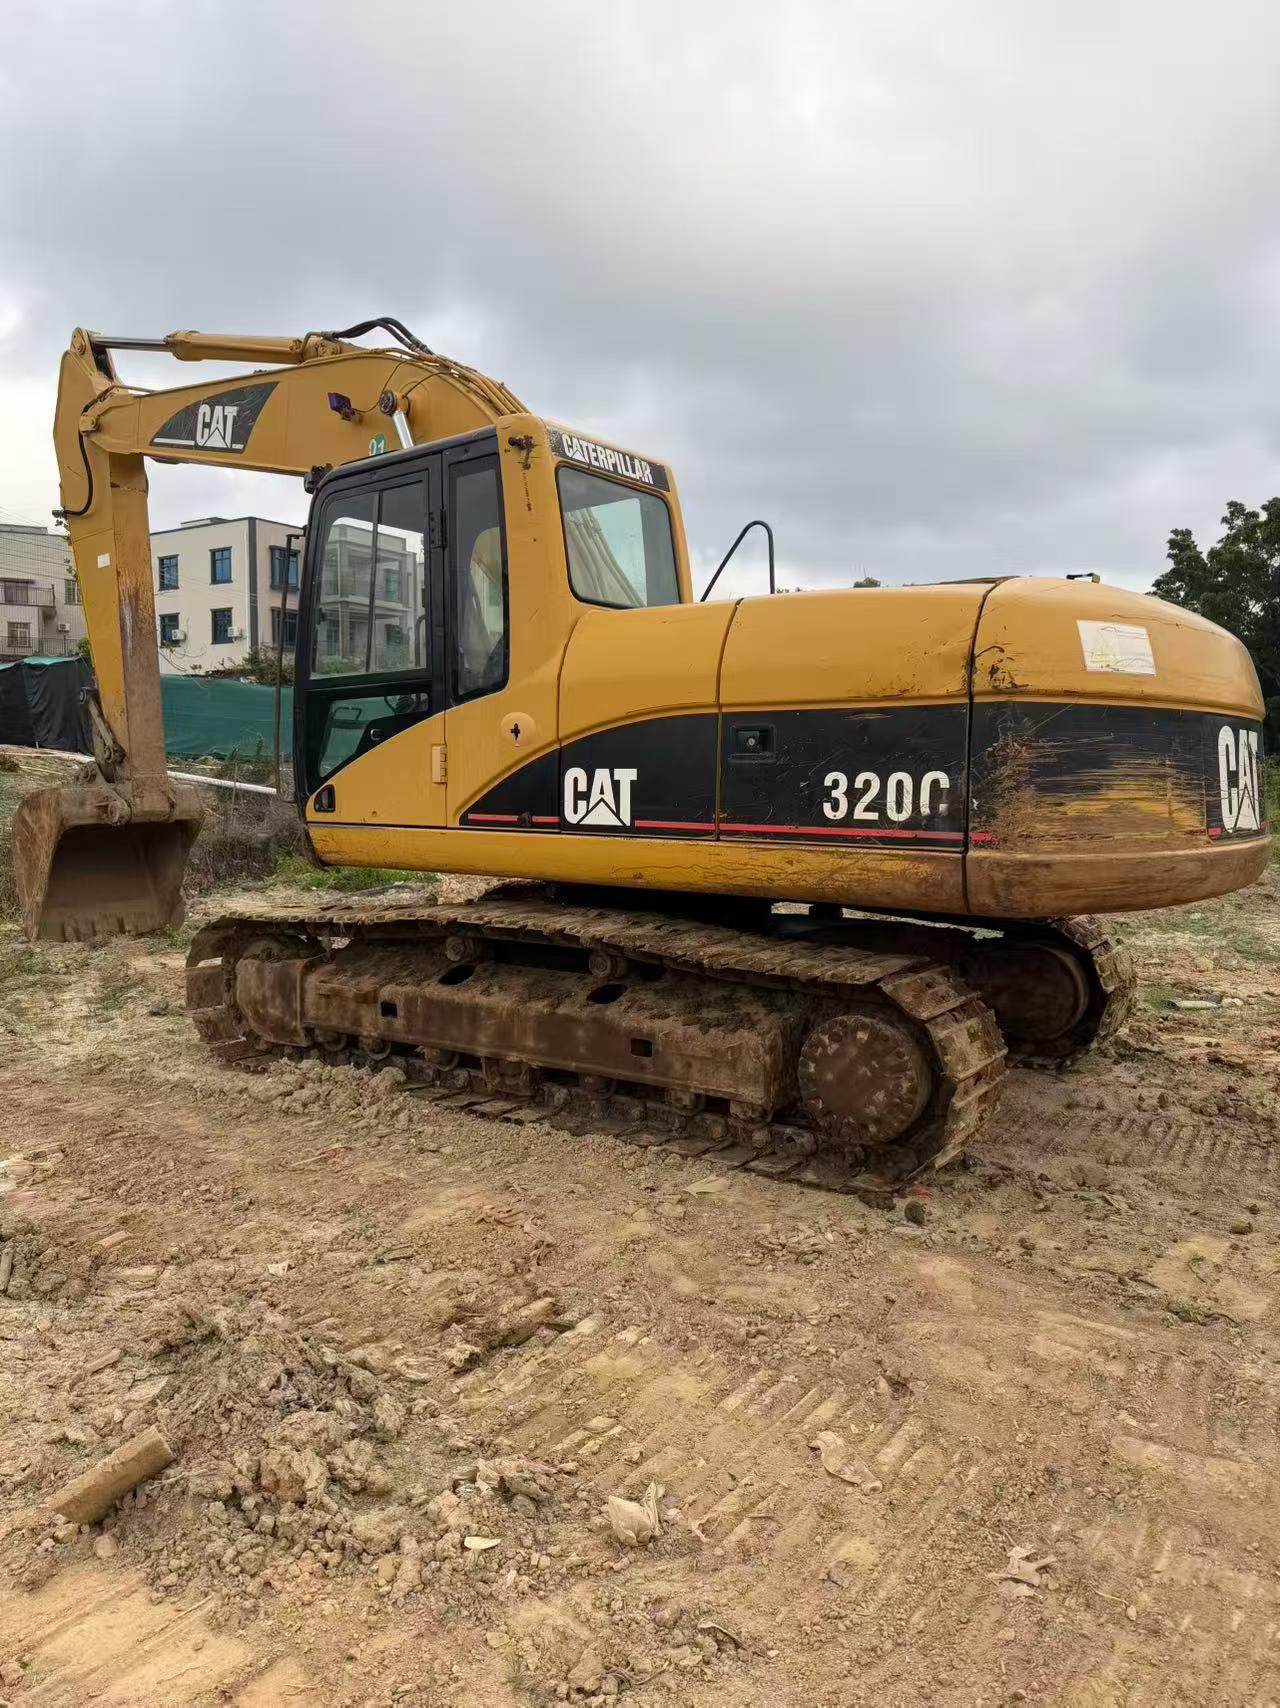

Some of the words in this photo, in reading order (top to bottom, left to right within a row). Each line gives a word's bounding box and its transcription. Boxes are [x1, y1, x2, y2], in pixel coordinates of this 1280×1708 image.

[196, 404, 238, 448] CAT
[562, 433, 654, 485] CATERPILLAR
[564, 767, 638, 826] CAT
[823, 770, 950, 822] 320C
[1218, 725, 1260, 833] CAT
